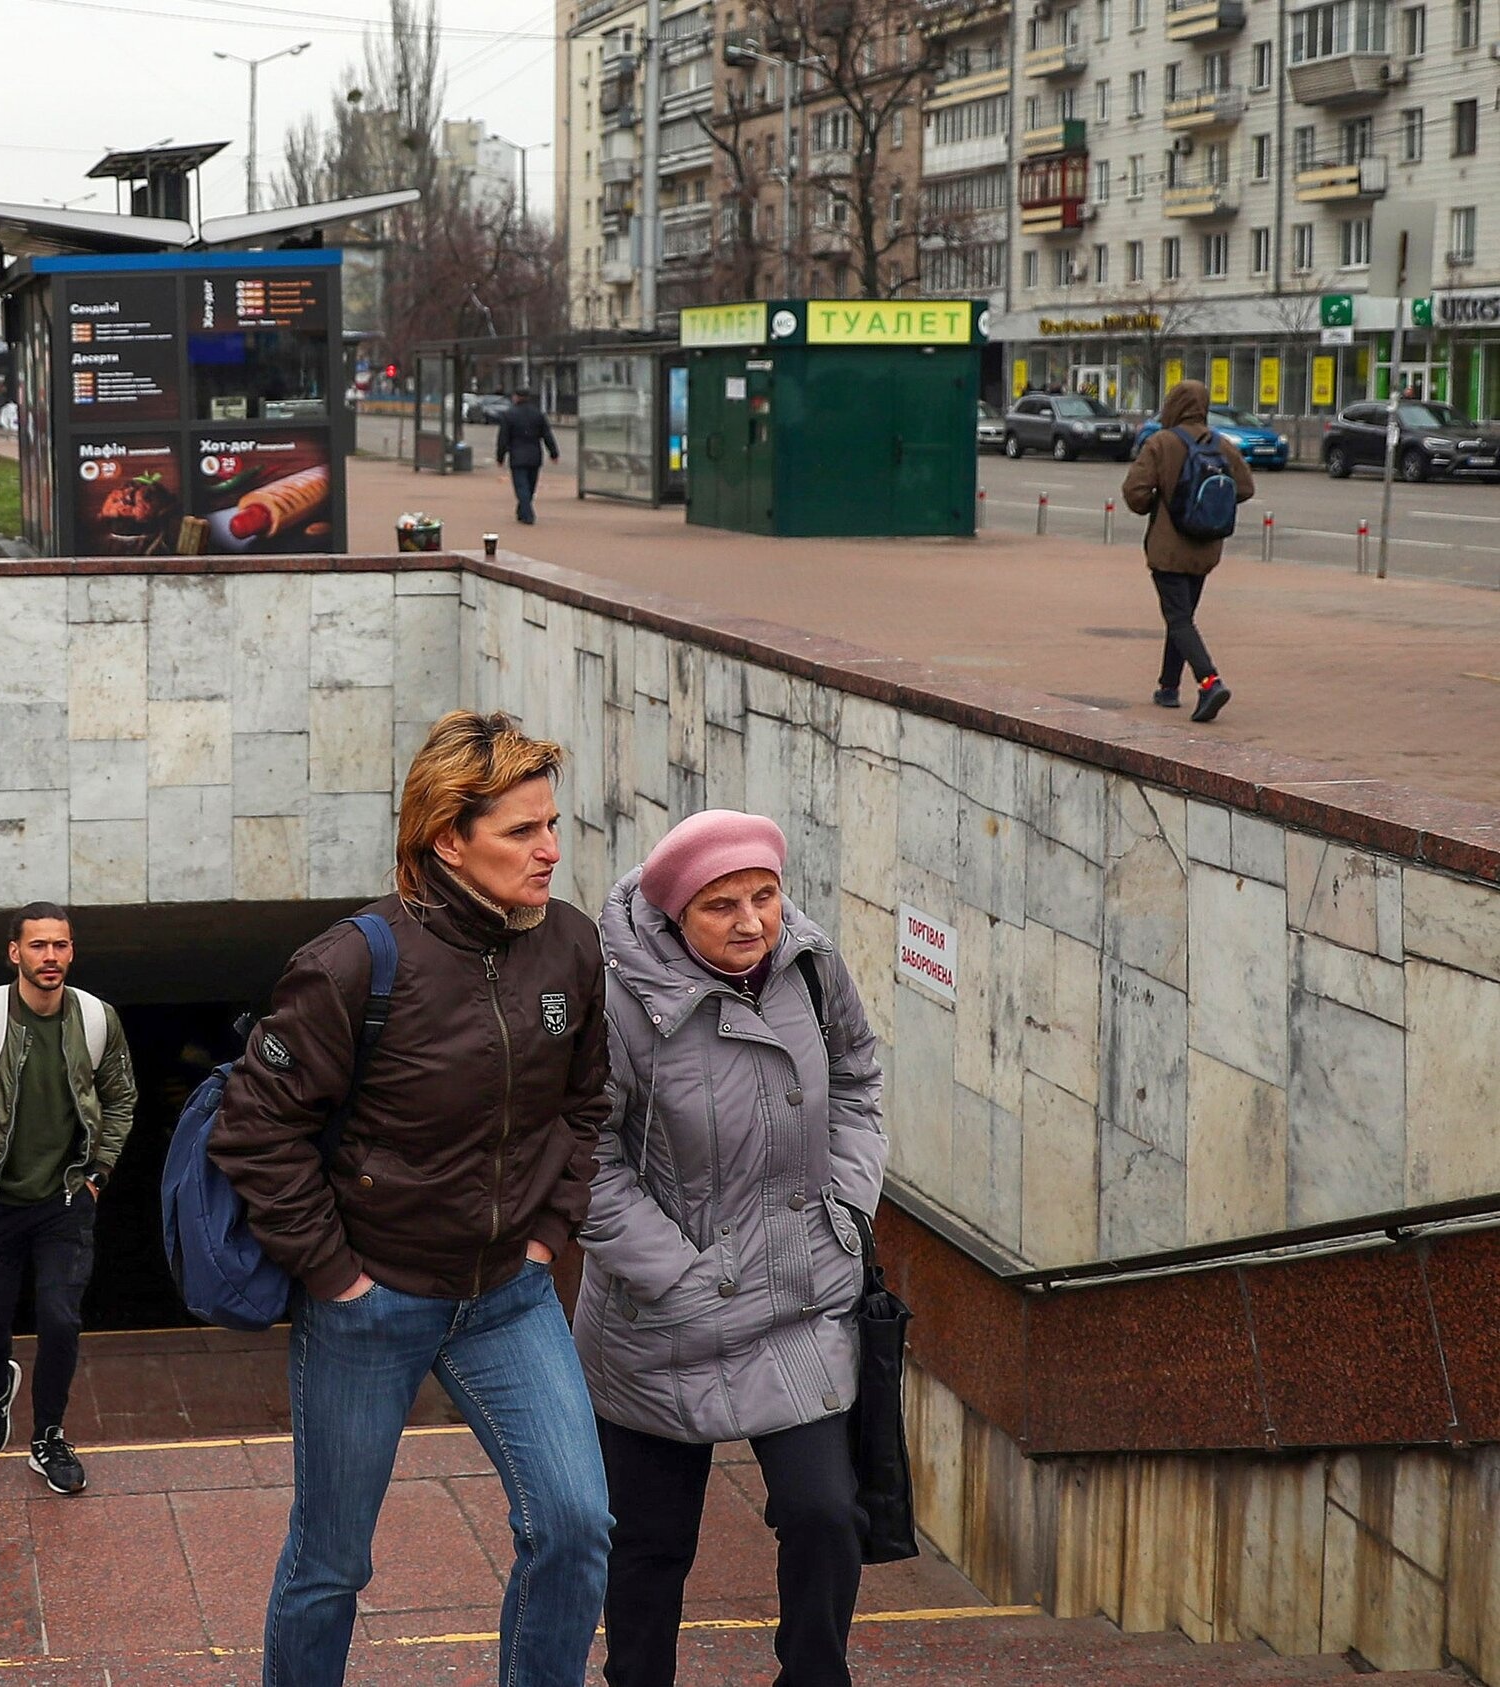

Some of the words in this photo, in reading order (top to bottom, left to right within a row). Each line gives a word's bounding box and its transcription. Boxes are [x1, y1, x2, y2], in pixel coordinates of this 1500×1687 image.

[820, 311, 961, 335] ТУАЛЕТ
[71, 353, 120, 365] Десерти
[79, 443, 127, 459] Мафін
[200, 439, 256, 454] Хот-дог
[908, 917, 945, 950] ТОРГІВЛЯ
[902, 946, 953, 987] ЗАБОРОНЕНА
